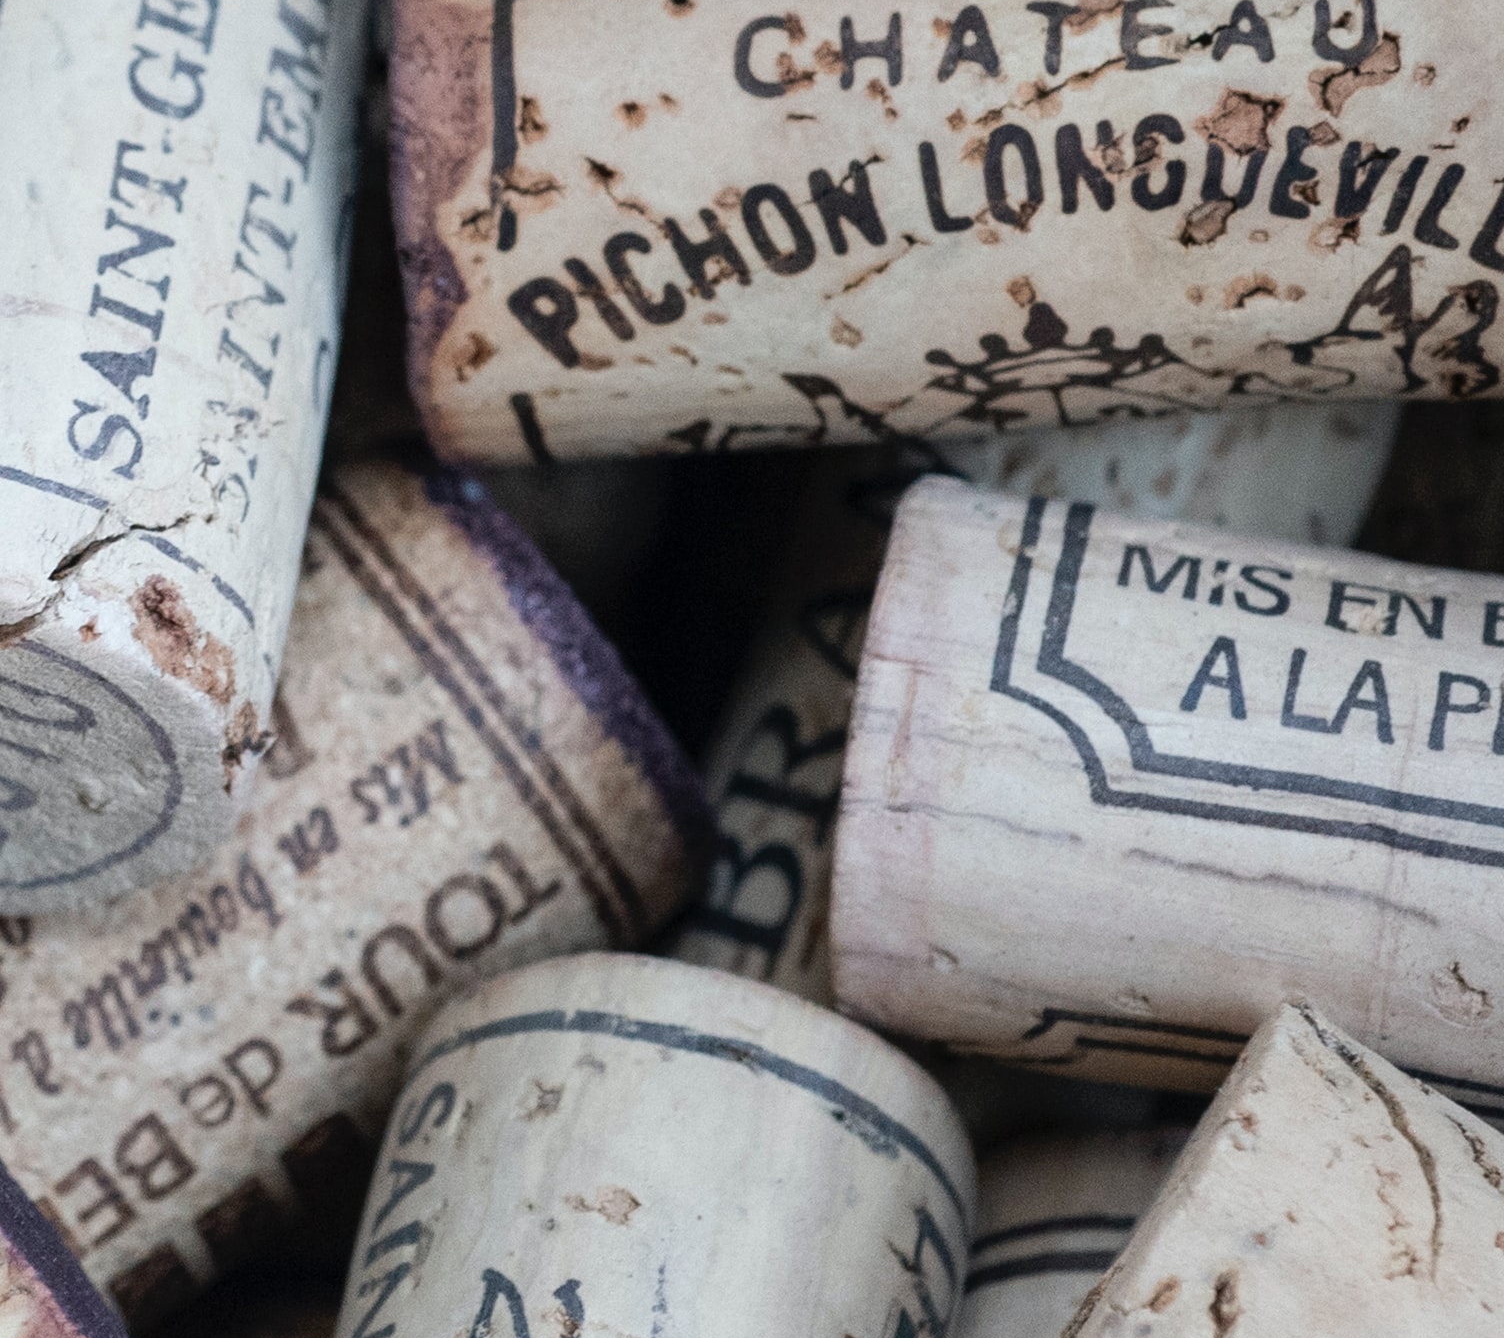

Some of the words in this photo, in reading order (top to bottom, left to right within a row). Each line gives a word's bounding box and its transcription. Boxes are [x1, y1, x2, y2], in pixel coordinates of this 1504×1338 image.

[504, 157, 896, 371] PICHON
[1114, 541, 1296, 620] MIS
[1325, 577, 1449, 640] EN
[1178, 635, 1249, 724] A
[1279, 645, 1398, 745] LA
[354, 723, 466, 829] Mis
[280, 813, 342, 875] en
[308, 839, 566, 1059] TOUR
[182, 1025, 284, 1135] de
